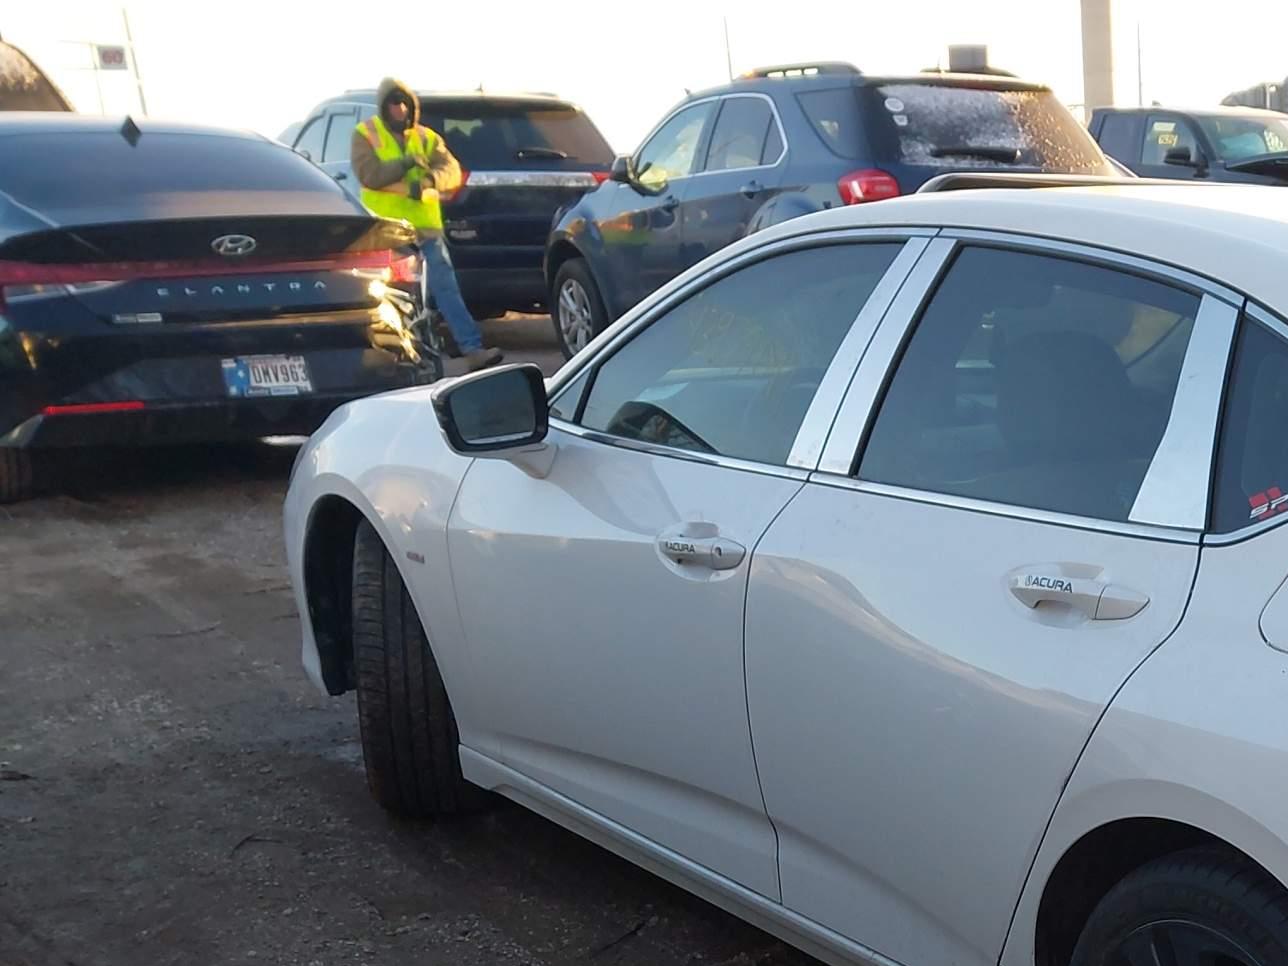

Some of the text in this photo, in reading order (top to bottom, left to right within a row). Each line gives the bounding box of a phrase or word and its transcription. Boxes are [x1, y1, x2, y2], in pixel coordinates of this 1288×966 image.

[156, 280, 327, 296] ELANTRA
[669, 542, 695, 553] ACURA
[1031, 576, 1073, 593] ACURA
